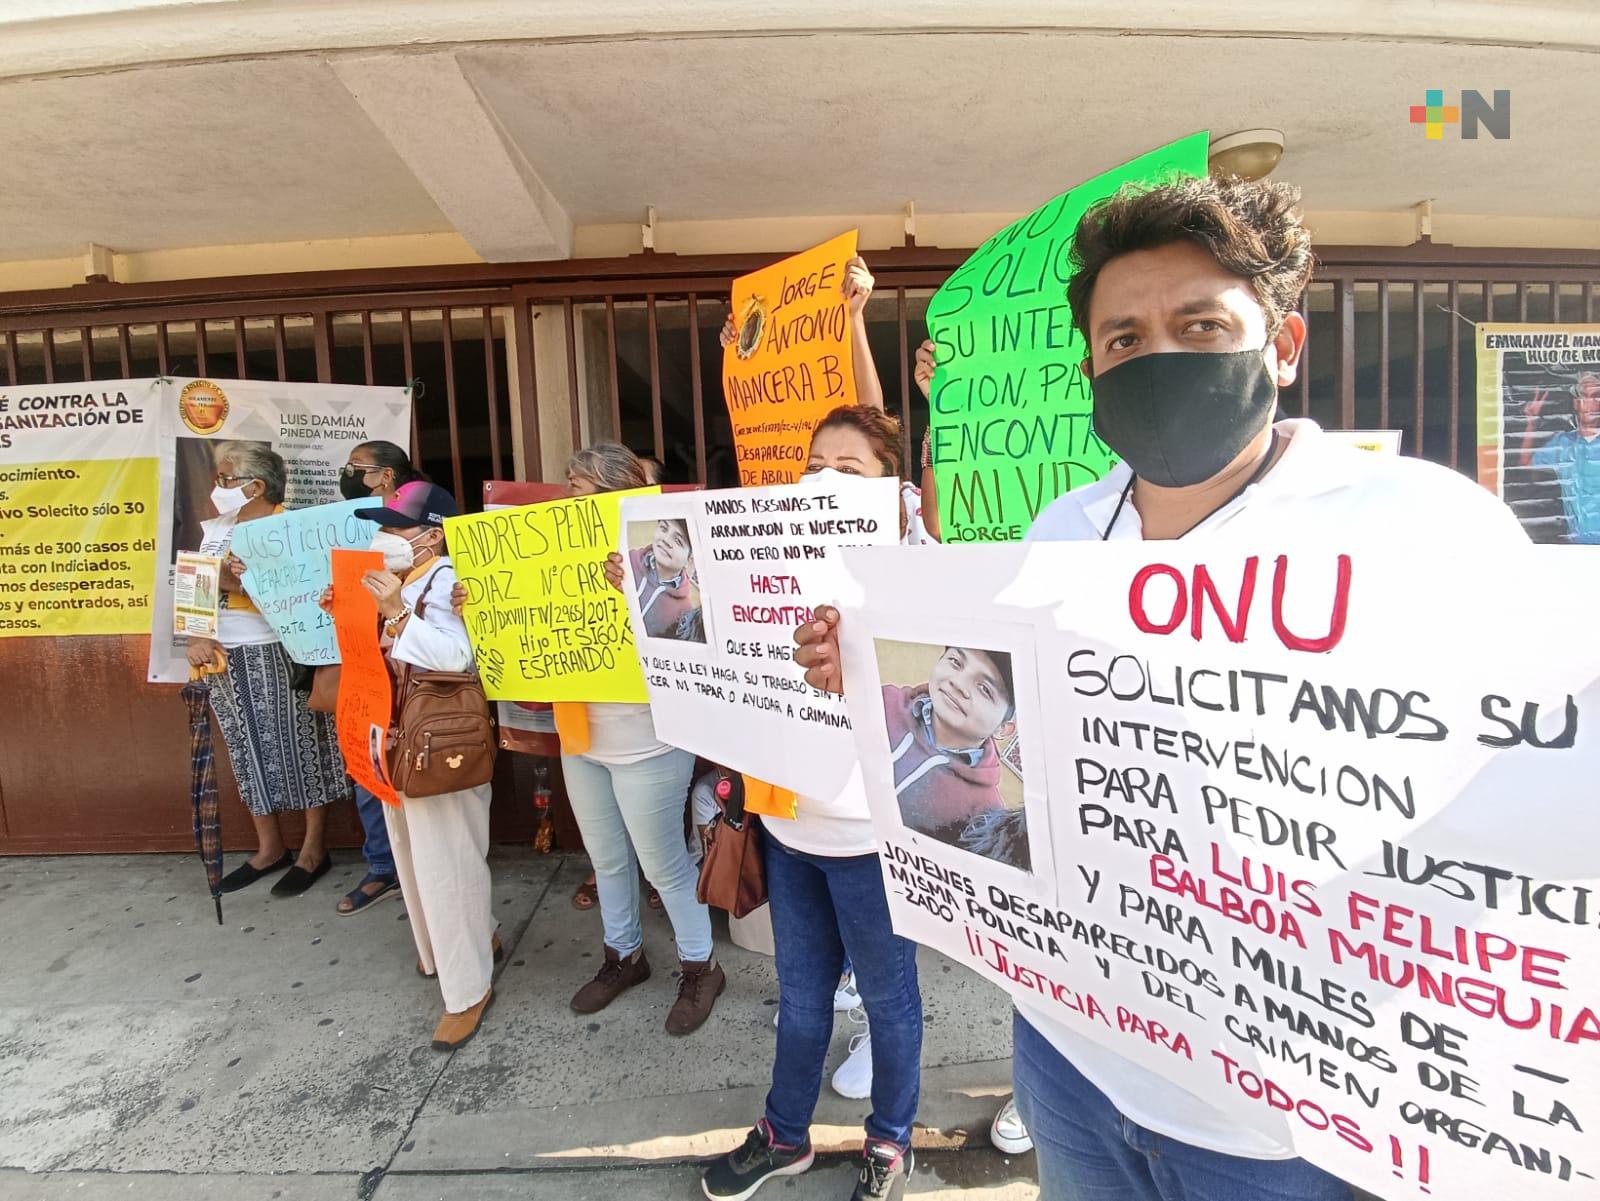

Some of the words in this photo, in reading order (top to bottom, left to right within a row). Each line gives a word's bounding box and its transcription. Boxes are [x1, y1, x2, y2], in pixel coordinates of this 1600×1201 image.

[771, 263, 836, 314] JORGE
[767, 303, 845, 354] ANTONIO
[935, 316, 975, 368] SU
[1486, 335, 1570, 348] EMMANUEL
[1527, 350, 1558, 363] HIJO
[1562, 350, 1579, 363] DE
[728, 363, 815, 412] MANCERA
[817, 355, 845, 398] B.
[936, 367, 1027, 415] CION,
[1039, 363, 1091, 402] PA
[19, 393, 98, 411] CONTRA
[102, 392, 128, 407] LA
[116, 409, 143, 424] DE
[280, 413, 308, 426] LUIS
[312, 413, 366, 428] DAMIÁN
[280, 427, 321, 439] PINEDA
[324, 430, 368, 440] MEDINA
[299, 459, 330, 467] hombre
[742, 470, 757, 485] DE
[303, 478, 314, 486] de
[950, 468, 1004, 525] MI
[27, 504, 88, 518] Solecito
[92, 502, 120, 516] sólo
[124, 502, 144, 514] 30
[705, 500, 746, 515] MANOS
[751, 498, 811, 514] ASESINAS
[811, 495, 839, 510] TE
[454, 511, 549, 571] ANDRES
[546, 497, 610, 552] PEÑA
[711, 521, 783, 538] ARRANCARON
[790, 522, 805, 536] DE
[809, 518, 878, 536] NUESTRO
[0, 543, 30, 556] más
[34, 542, 53, 554] de
[56, 541, 81, 554] 300
[85, 542, 128, 553] casos
[133, 538, 156, 551] del
[713, 548, 745, 561] LADO
[750, 547, 780, 560] PERO
[783, 545, 800, 560] NO
[21, 562, 47, 573] con
[51, 558, 131, 573] Indiciados.
[30, 577, 134, 593] desesperadas,
[461, 570, 521, 606] DIAZ
[750, 574, 801, 595] HASTA
[15, 601, 24, 613] y
[29, 596, 124, 610] encontrados,
[128, 594, 148, 608] así
[1129, 554, 1352, 653] ONU
[551, 627, 570, 650] TE
[575, 624, 618, 646] SIGO
[727, 639, 748, 656] QUE
[749, 641, 764, 658] SE
[486, 648, 505, 690] AMO
[519, 646, 615, 680] ESPERANDO
[653, 657, 671, 672] QUE
[674, 661, 688, 674] LA
[690, 662, 708, 677] LEY
[712, 666, 740, 684] HAGA
[744, 672, 758, 685] SU
[676, 679, 690, 692] NI
[694, 682, 725, 701] TAPAR
[742, 693, 783, 714] AYUDAR
[786, 703, 795, 719] A
[1067, 650, 1449, 742] SOLICITAMOS
[1476, 694, 1578, 750] SU
[1083, 716, 1415, 819] INTERVENCION
[1075, 758, 1178, 814] PARA
[1201, 785, 1348, 871] PEDIR
[1363, 840, 1600, 930] JUSTICI
[1079, 803, 1189, 863] PARA
[1211, 842, 1321, 917] LUIS
[1348, 890, 1571, 991] FELIPE
[1150, 854, 1308, 950] BALBOA
[1327, 928, 1600, 1045] MUNGUIA
[1077, 864, 1101, 903] Y
[1119, 883, 1214, 955] PARA
[1232, 936, 1376, 1028] MILES
[1401, 1010, 1468, 1067] DE
[884, 841, 975, 897] JOVENES
[987, 885, 1225, 998] DESAPARECIDOS
[1234, 983, 1257, 1013] A
[1263, 1000, 1398, 1074] MANOS
[1418, 1062, 1487, 1108] DE
[1512, 1090, 1584, 1133] LA
[888, 863, 961, 911] MISMA
[964, 899, 1069, 963] POLICIA
[1141, 971, 1208, 1021] DEL
[1225, 1014, 1380, 1108] CRIMEN
[1117, 1005, 1193, 1062] PARA
